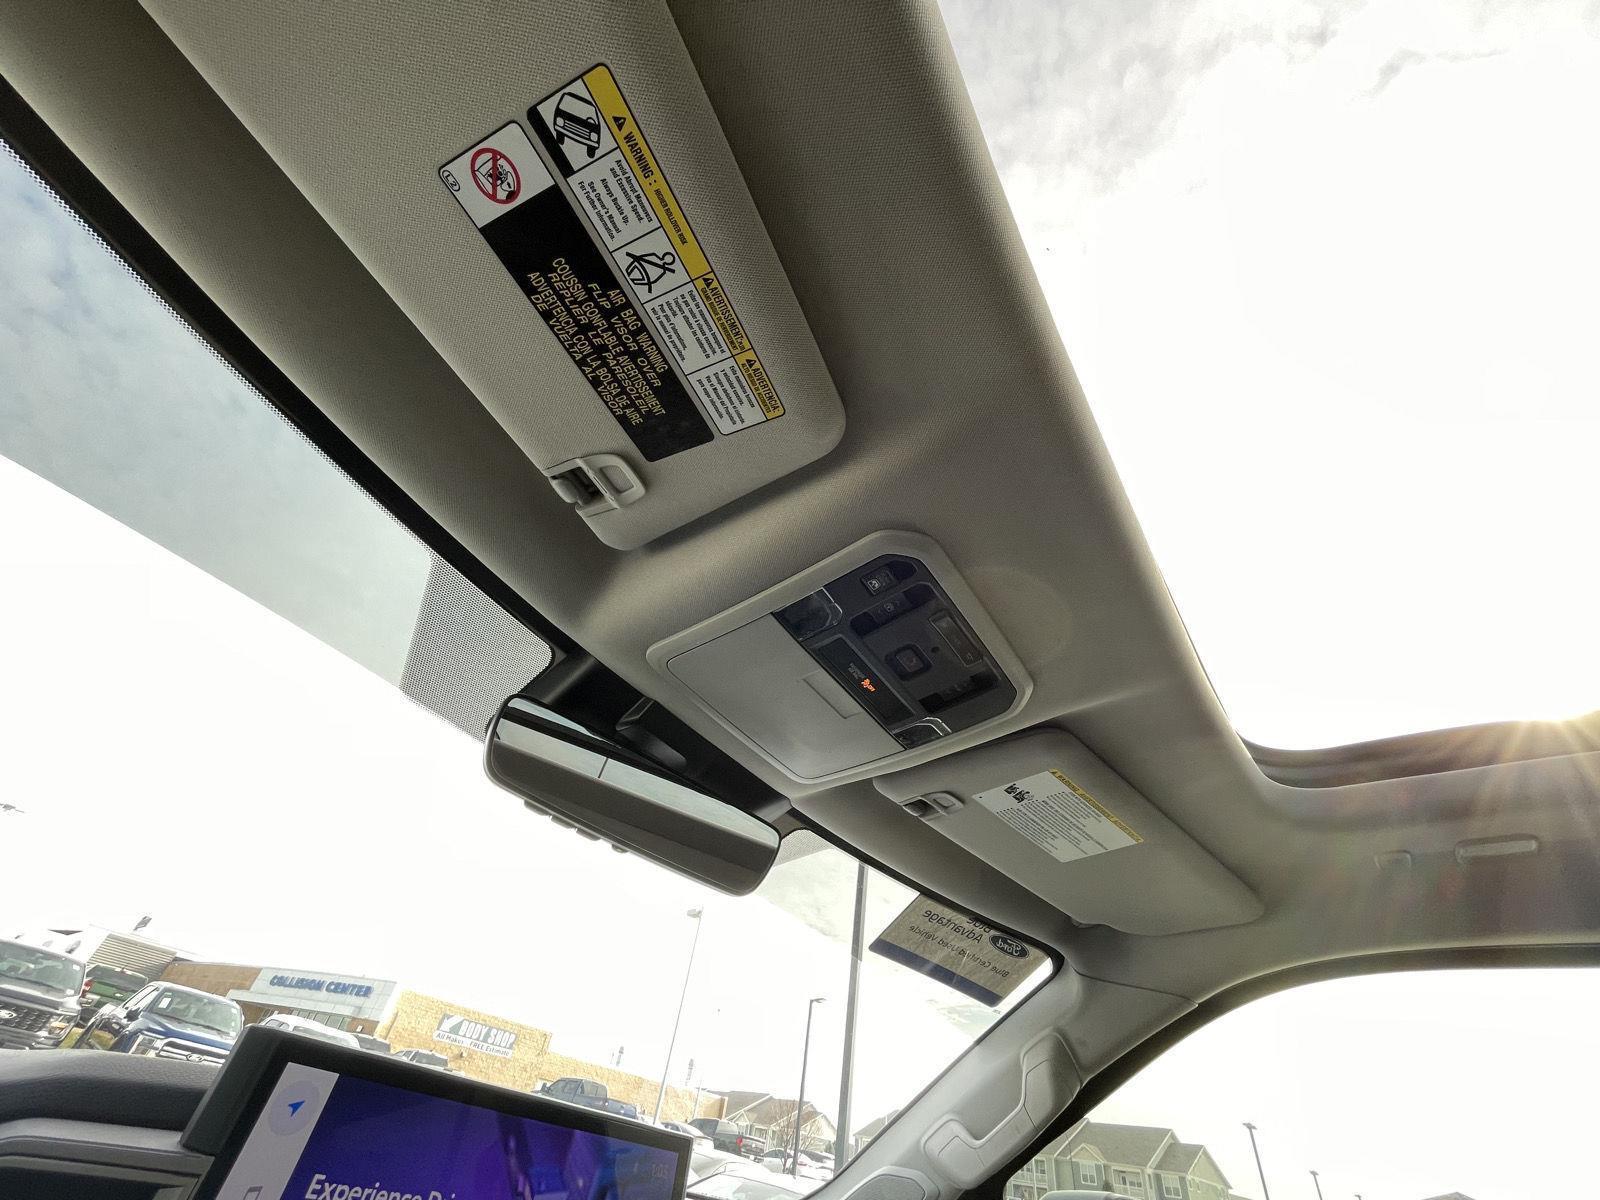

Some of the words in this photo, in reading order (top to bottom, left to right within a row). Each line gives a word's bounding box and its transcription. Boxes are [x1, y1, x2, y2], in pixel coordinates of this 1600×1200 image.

[576, 179, 588, 192] For
[582, 190, 600, 212] Further
[594, 209, 618, 241] Information.
[586, 180, 598, 193] See
[593, 191, 611, 215] Owner's
[606, 213, 622, 234] Manual
[598, 177, 616, 199] Always
[610, 196, 626, 216] Buckle
[620, 214, 631, 226] Up.
[608, 165, 620, 179] and
[615, 177, 635, 205] Excessive
[629, 203, 645, 224] Speed.
[614, 158, 628, 176] Avoid
[623, 174, 638, 195] Abrupt
[633, 193, 654, 223] Maneuvers
[622, 130, 654, 179] WARNING
[653, 187, 669, 209] HIGHER
[663, 206, 682, 233] ROLLOVER
[676, 232, 688, 245] RISK
[525, 269, 579, 336] ADVERTENCIA
[606, 286, 627, 307] AIR
[619, 307, 642, 331] BAG
[634, 331, 669, 374] WARNING
[529, 292, 549, 313] DE
[547, 316, 584, 361] VUELTA
[580, 363, 598, 381] AL
[595, 384, 624, 417] VISOR
[546, 270, 589, 325] REPLIER
[586, 328, 605, 348] LE
[601, 349, 651, 415] PARESOLEIL
[550, 255, 589, 302] COUSSIN
[580, 299, 624, 355] GONFLABLE
[615, 352, 666, 418] AVERTISSEMENT
[570, 332, 594, 356] CON
[585, 353, 603, 369] LA
[586, 280, 612, 311] FLIP
[609, 314, 639, 352] VISOR
[635, 355, 662, 388] OVER
[594, 366, 622, 396] BOLSA
[614, 393, 631, 408] DE
[622, 405, 644, 426] AIRE
[325, 981, 374, 998] CENTER
[305, 1173, 421, 1200] Experie
